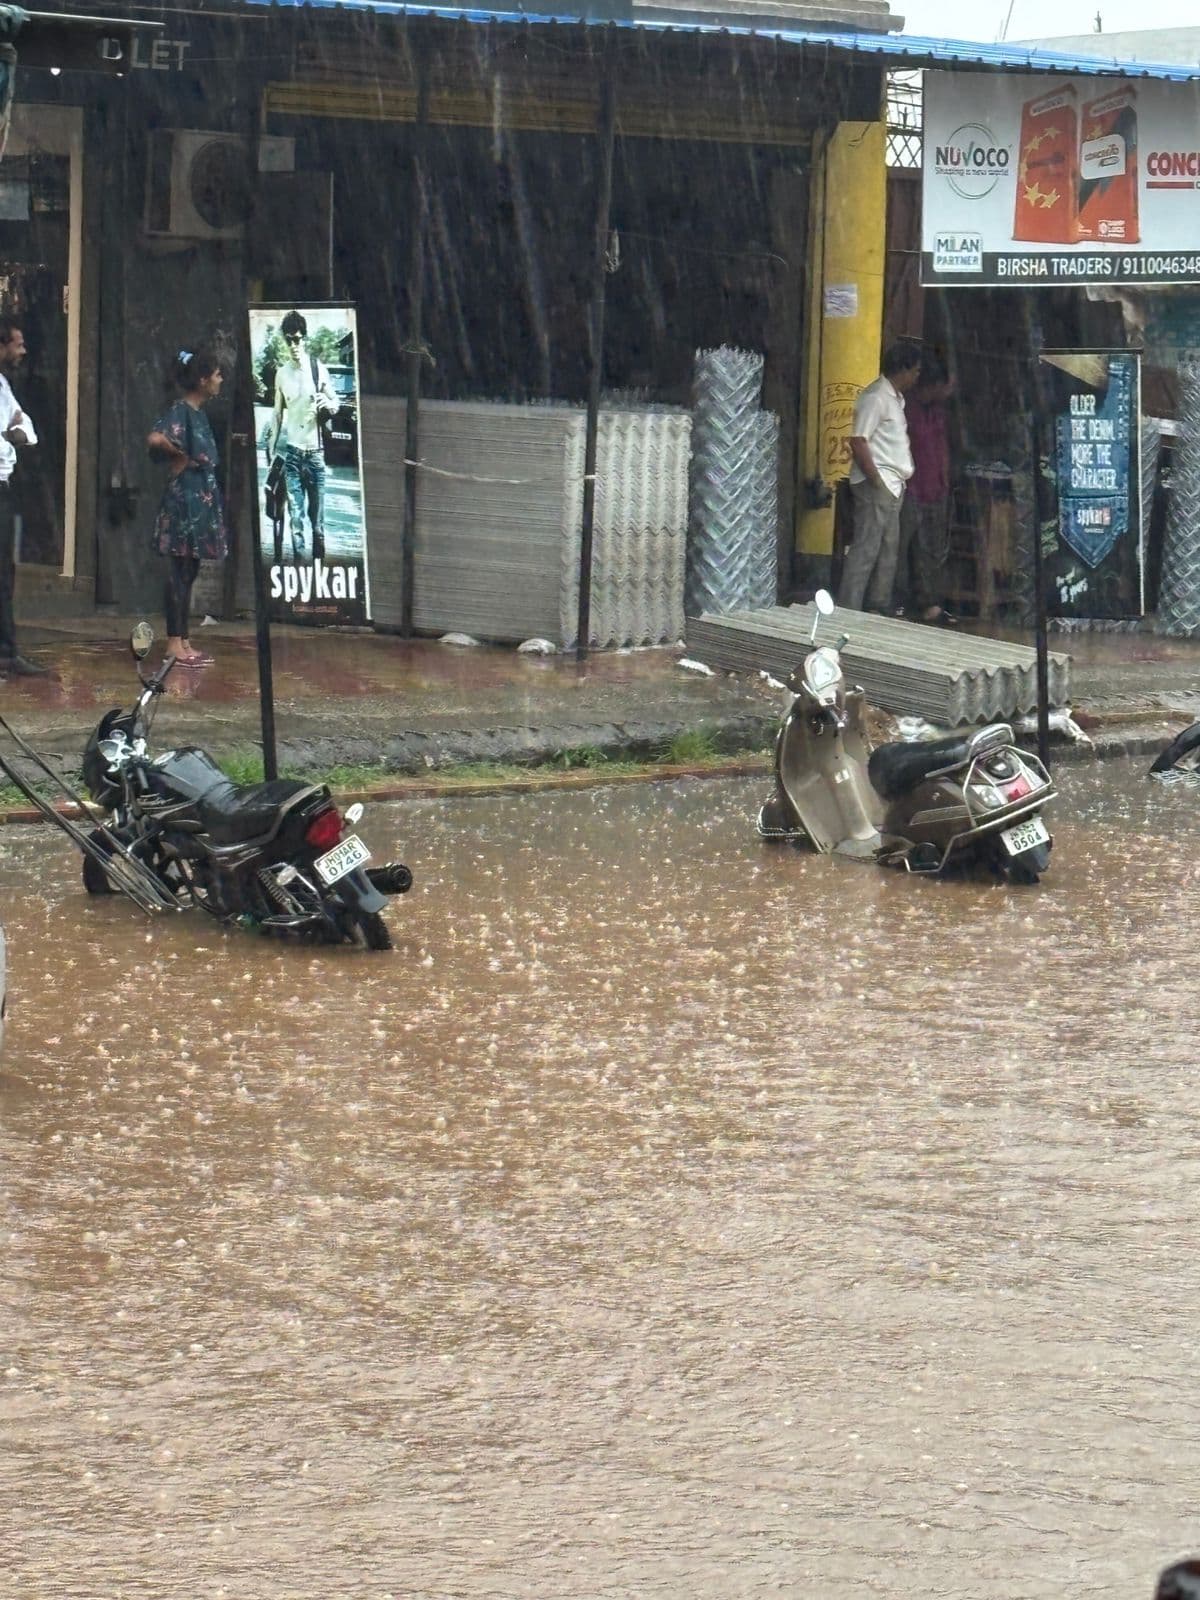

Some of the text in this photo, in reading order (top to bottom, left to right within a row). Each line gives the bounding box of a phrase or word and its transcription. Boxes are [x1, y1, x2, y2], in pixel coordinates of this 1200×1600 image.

[935, 141, 1010, 168] NUVOCO
[1146, 151, 1200, 176] CONC
[936, 255, 979, 266] PARTNER
[997, 258, 1049, 276] BIRSHA
[1050, 257, 1113, 275] TRADERS
[1122, 256, 1200, 275] 9110046348
[1070, 419, 1087, 440] THE
[270, 557, 358, 603] spykar
[328, 849, 363, 876] 0746
